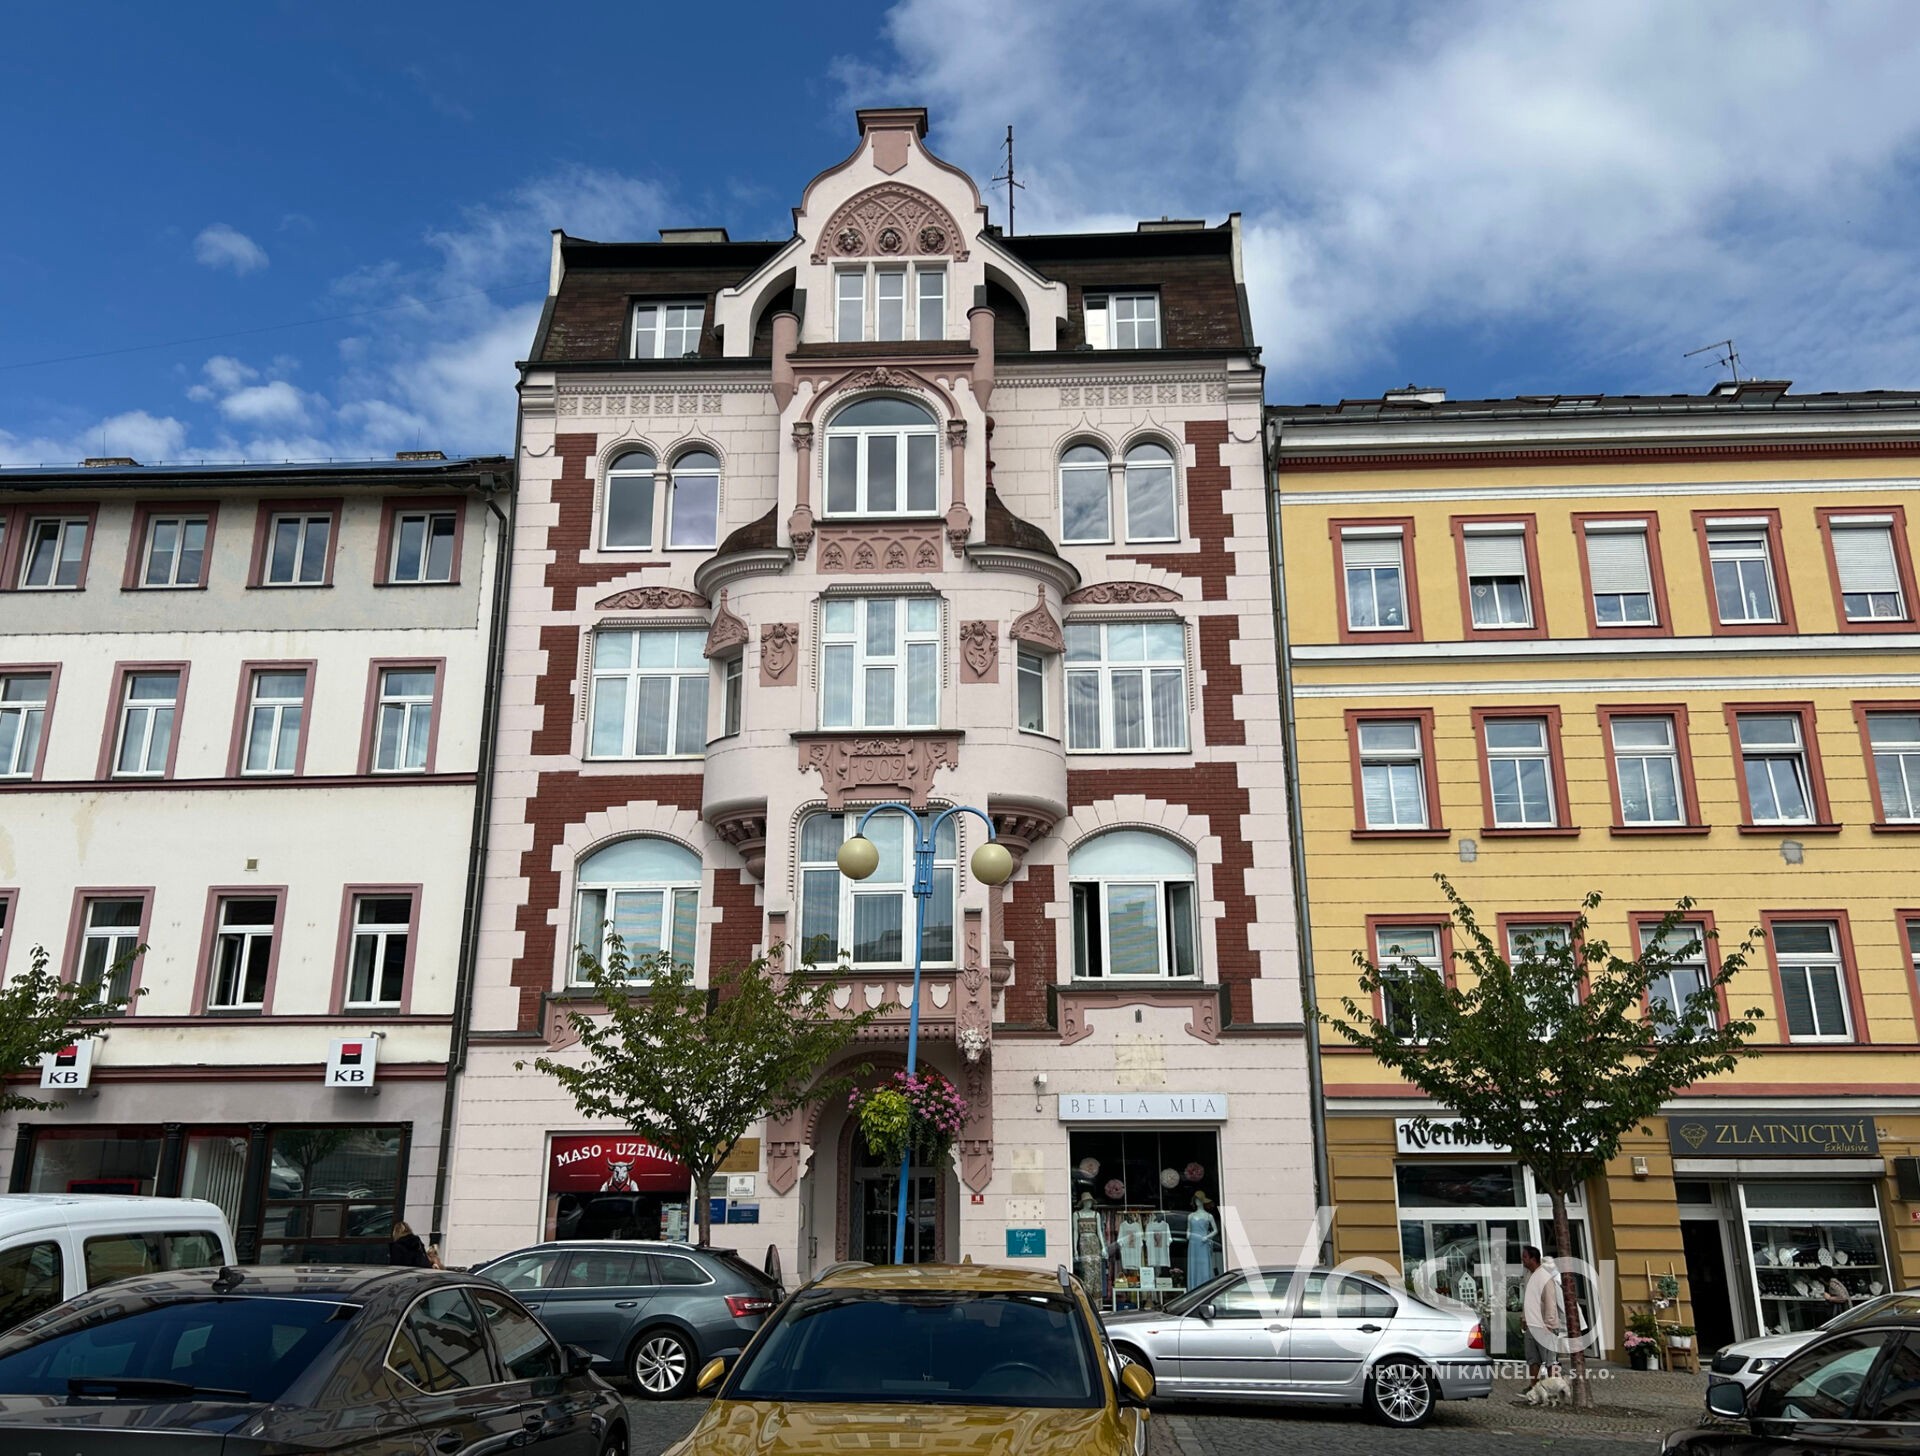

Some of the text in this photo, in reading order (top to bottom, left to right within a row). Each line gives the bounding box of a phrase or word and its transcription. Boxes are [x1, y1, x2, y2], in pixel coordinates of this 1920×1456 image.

[852, 758, 904, 781] 1902
[48, 1071, 79, 1084] KB
[334, 1069, 365, 1082] KB
[1071, 1098, 1216, 1113] BELLA MIA
[1714, 1119, 1867, 1144] ZLATNICTVÍ
[1824, 1142, 1869, 1152] Exklusive
[556, 1144, 602, 1167] MASO
